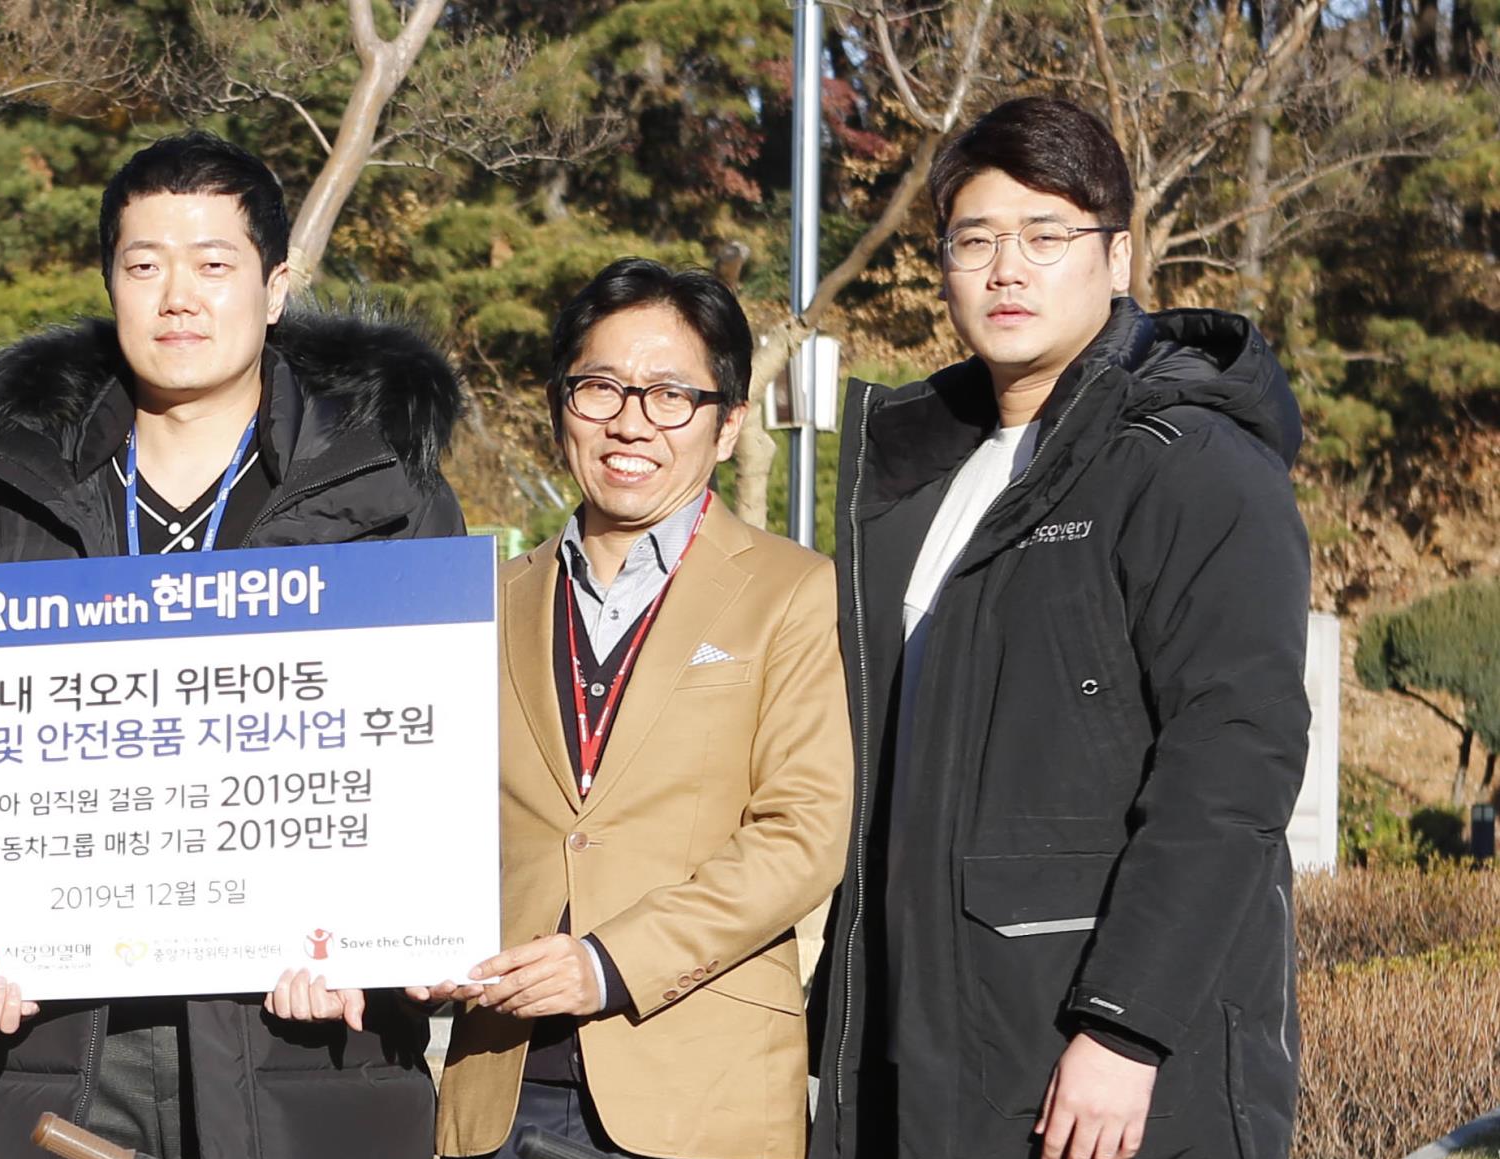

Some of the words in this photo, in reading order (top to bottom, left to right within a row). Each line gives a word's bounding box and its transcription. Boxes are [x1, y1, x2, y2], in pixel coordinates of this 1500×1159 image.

[76, 594, 148, 625] with
[152, 566, 324, 621] 현대위아
[49, 669, 158, 712] 격오지
[176, 661, 328, 705] 위탁아동
[38, 718, 185, 762] 안전용품
[198, 709, 345, 752] 지원사업
[360, 704, 433, 746] 후원
[30, 789, 97, 816] 임직원
[110, 787, 154, 812] 걸음
[166, 784, 209, 808] 기금
[221, 769, 371, 806] 2019만원
[105, 831, 149, 855] 매칭
[162, 829, 206, 853] 기금
[217, 813, 367, 851] 2019만원
[52, 884, 133, 909] 2019년
[148, 882, 195, 905] 12월
[209, 880, 244, 904] 5일
[4, 943, 92, 964] 사랑의열매
[340, 935, 374, 949] Save
[376, 934, 400, 948] the
[402, 932, 466, 948] Children
